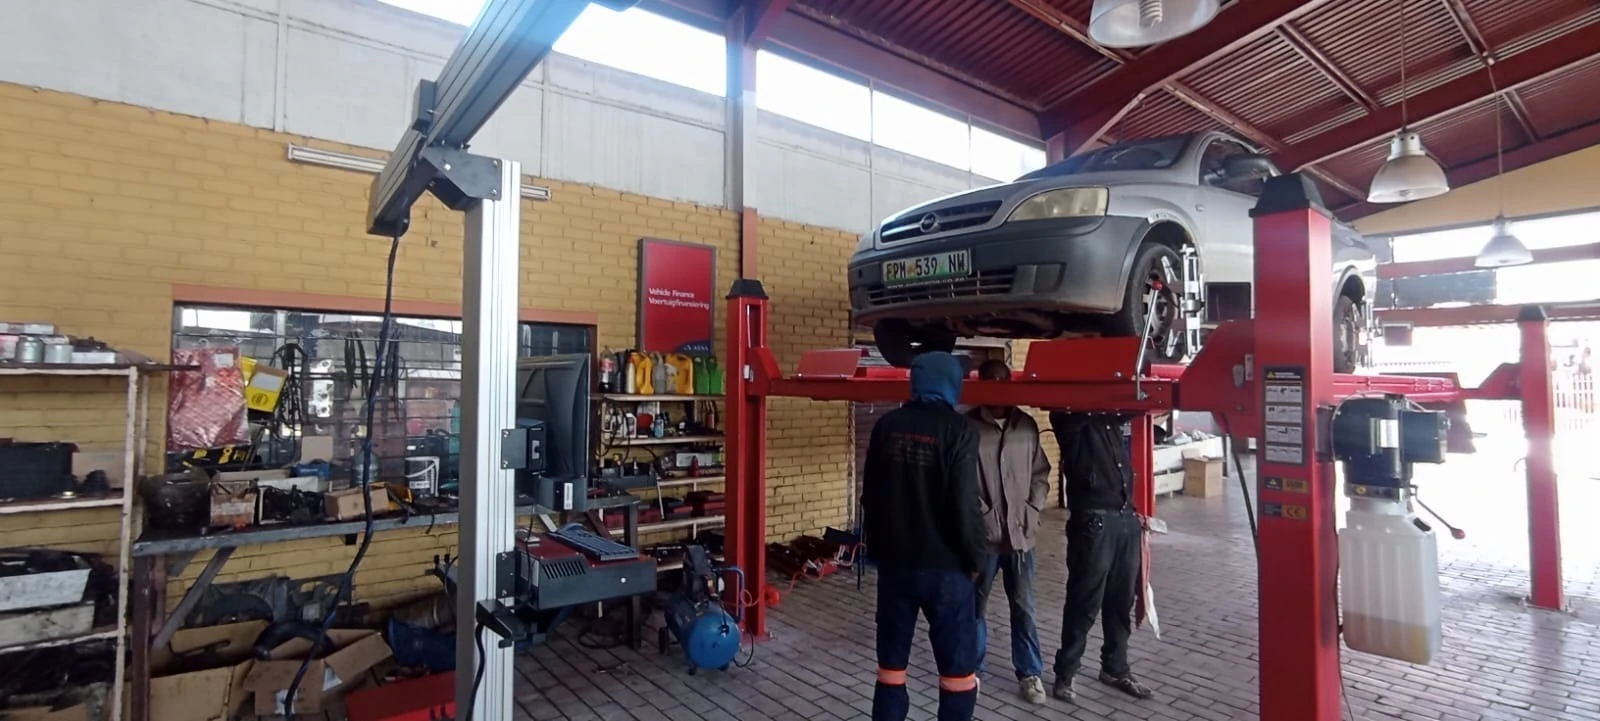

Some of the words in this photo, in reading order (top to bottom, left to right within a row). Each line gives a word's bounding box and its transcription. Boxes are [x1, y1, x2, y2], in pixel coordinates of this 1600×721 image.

[886, 261, 906, 280] FPM
[915, 256, 938, 276] 539
[948, 252, 965, 273] NW
[648, 287, 671, 296] Vehicle
[672, 289, 695, 298] Finance
